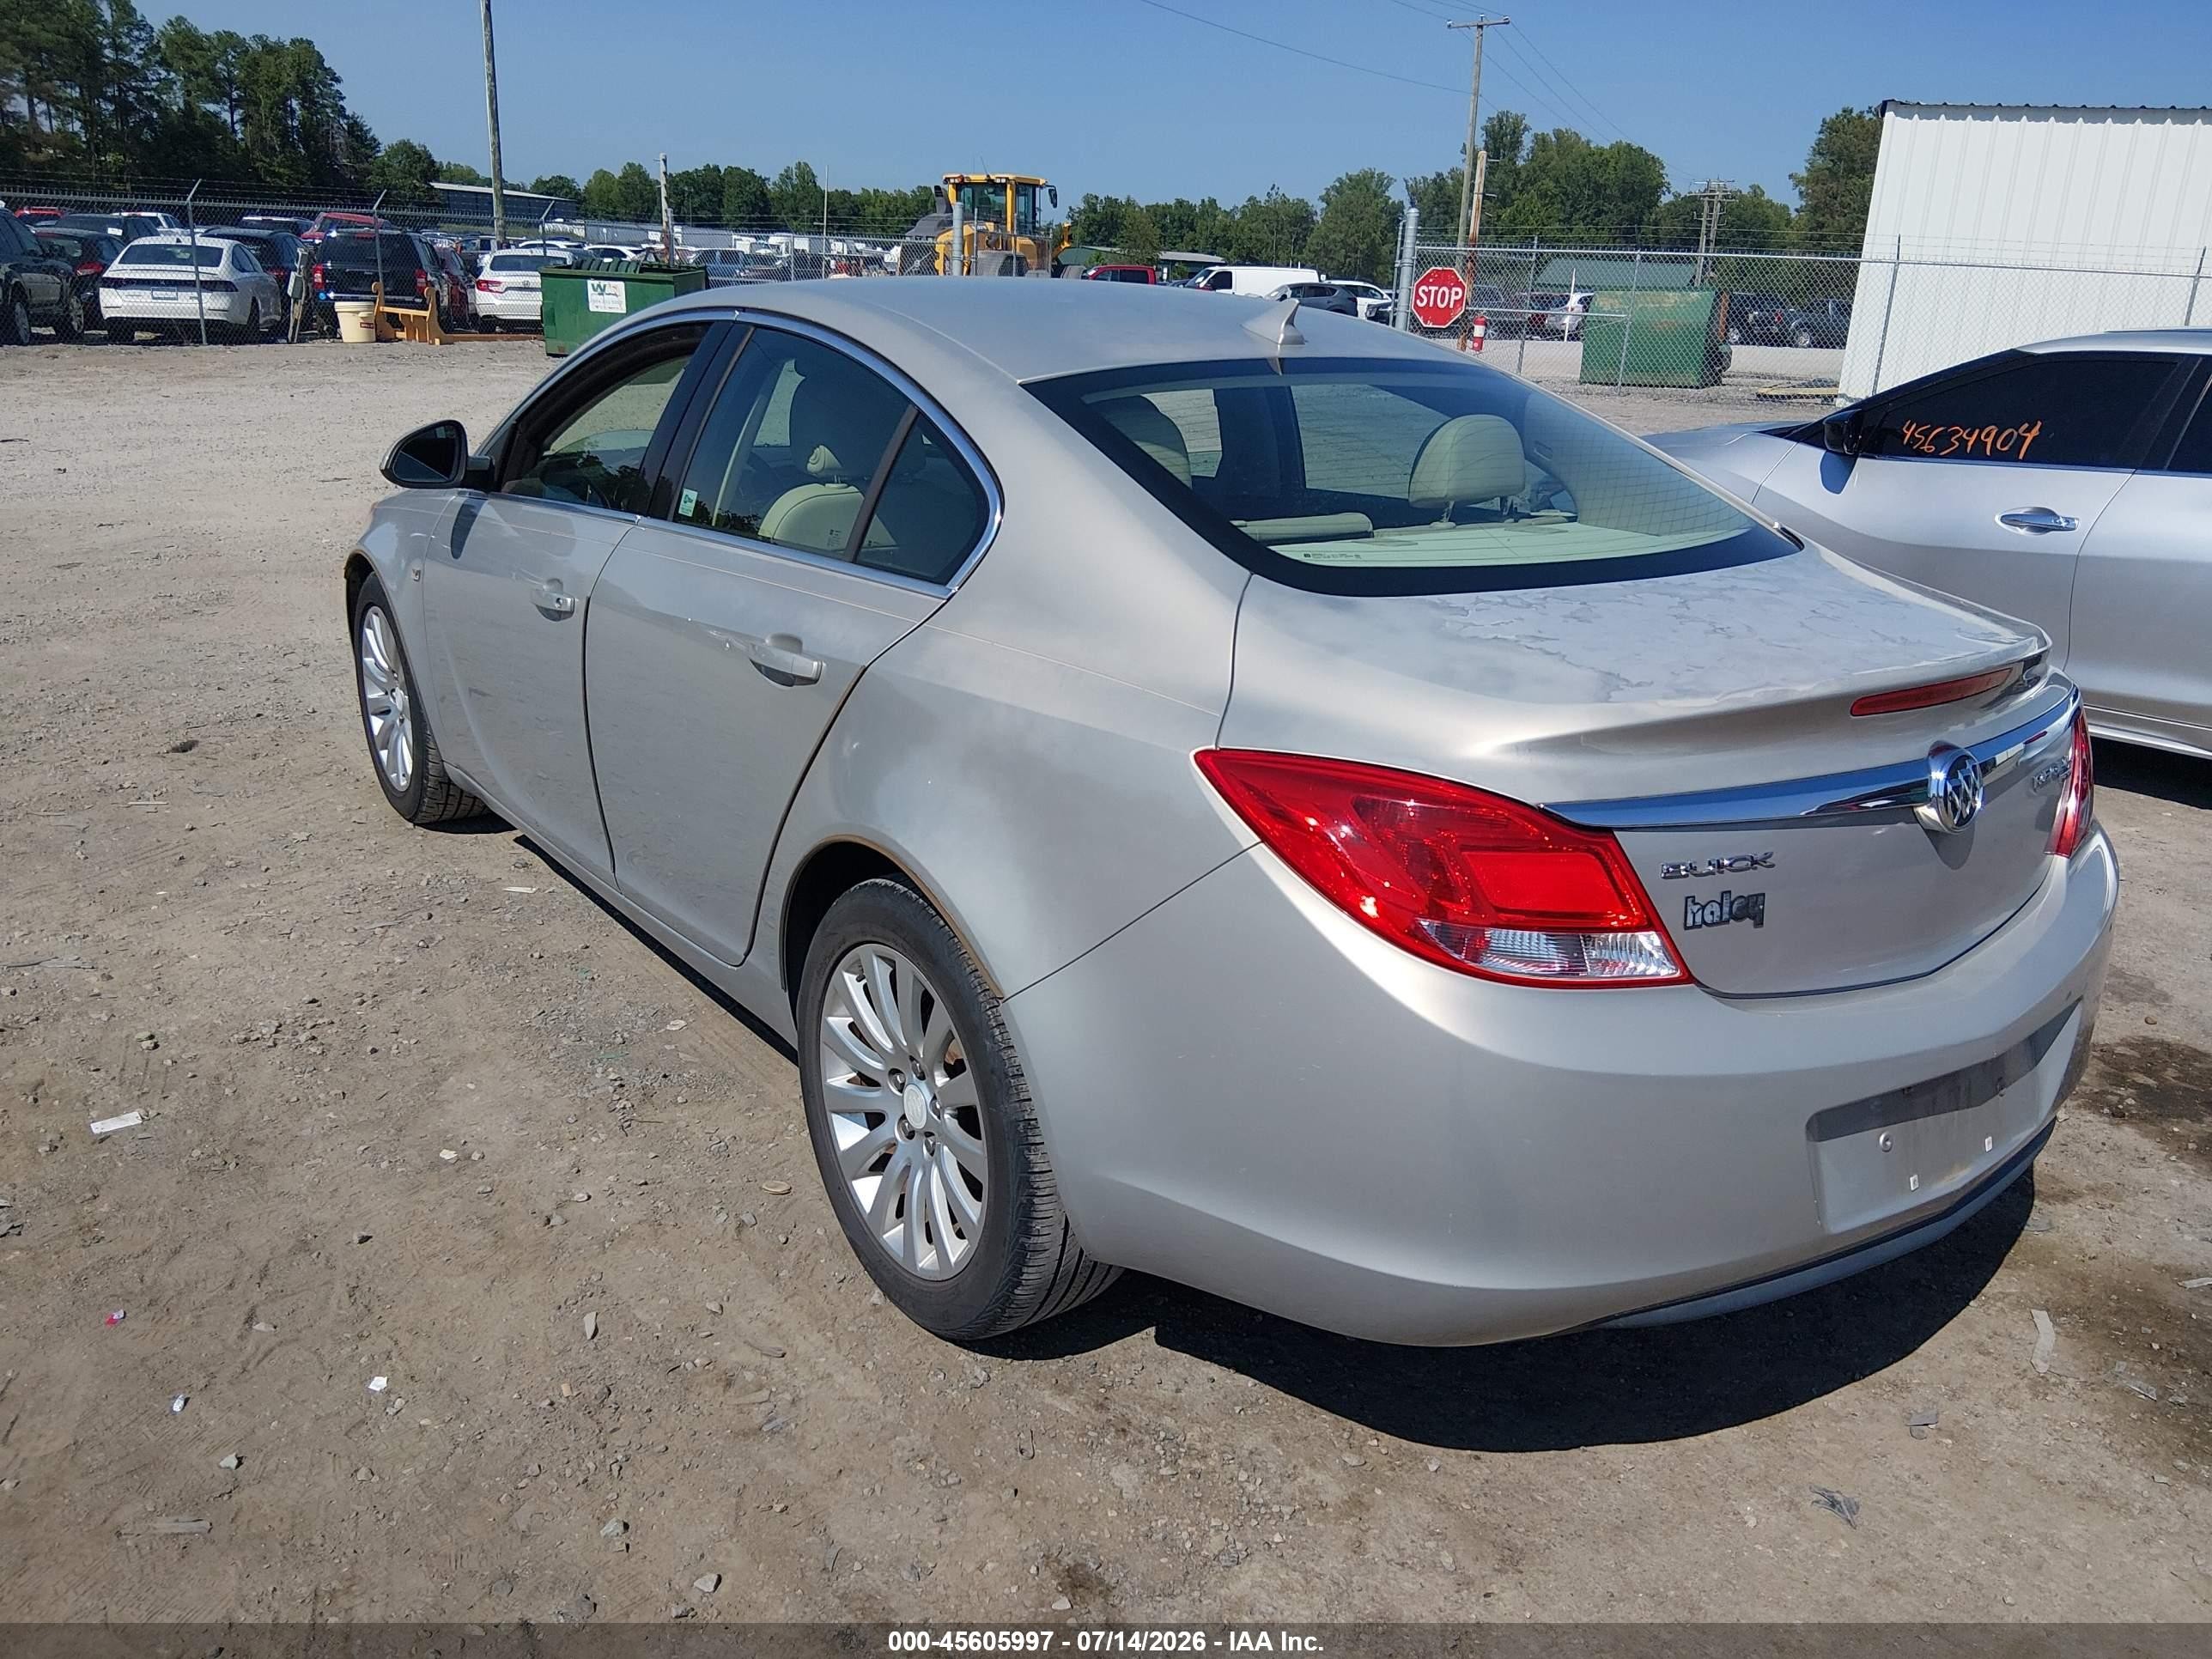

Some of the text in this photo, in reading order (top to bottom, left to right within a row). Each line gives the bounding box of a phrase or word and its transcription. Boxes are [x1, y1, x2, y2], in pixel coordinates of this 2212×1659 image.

[1416, 285, 1462, 309] STOP
[1902, 419, 2042, 460] 45634904
[1661, 851, 1776, 879] BUICK
